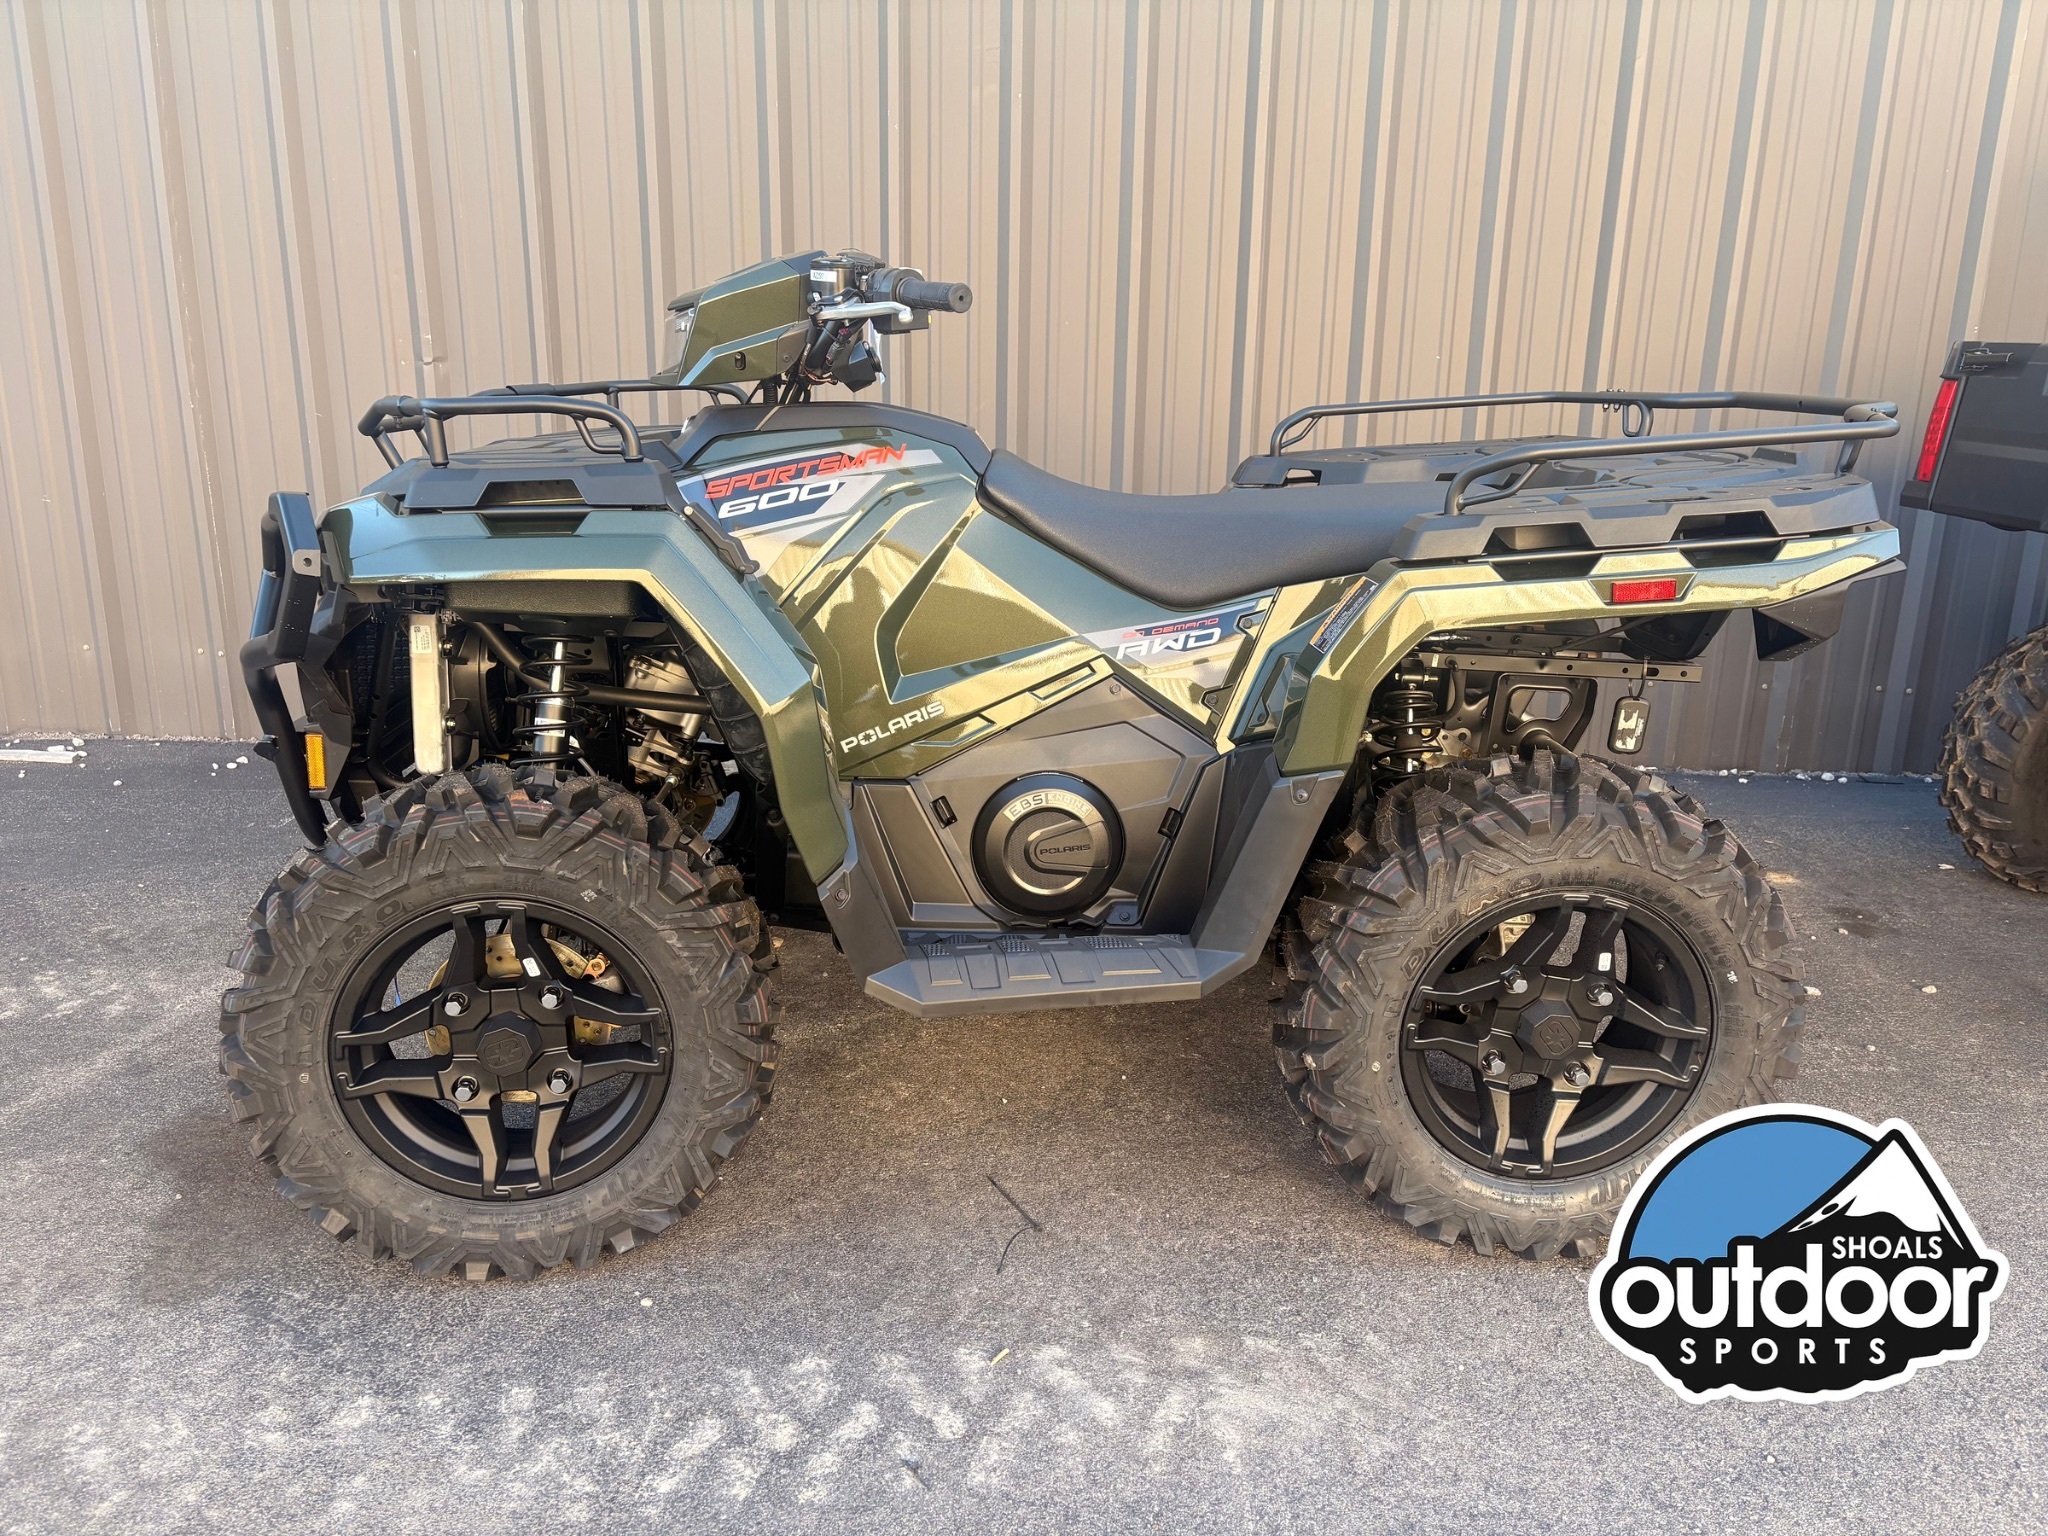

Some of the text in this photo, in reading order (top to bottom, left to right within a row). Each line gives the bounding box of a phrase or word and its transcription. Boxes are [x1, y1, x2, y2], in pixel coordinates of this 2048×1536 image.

[704, 443, 907, 499] SPORTSMAN
[718, 478, 840, 519] 600
[1116, 627, 1222, 660] AWD
[1151, 617, 1220, 635] DEMAND
[840, 700, 945, 754] POLARIS
[1008, 793, 1044, 818] EBS
[1039, 843, 1092, 856] POLARIS
[296, 899, 404, 1032] DURO
